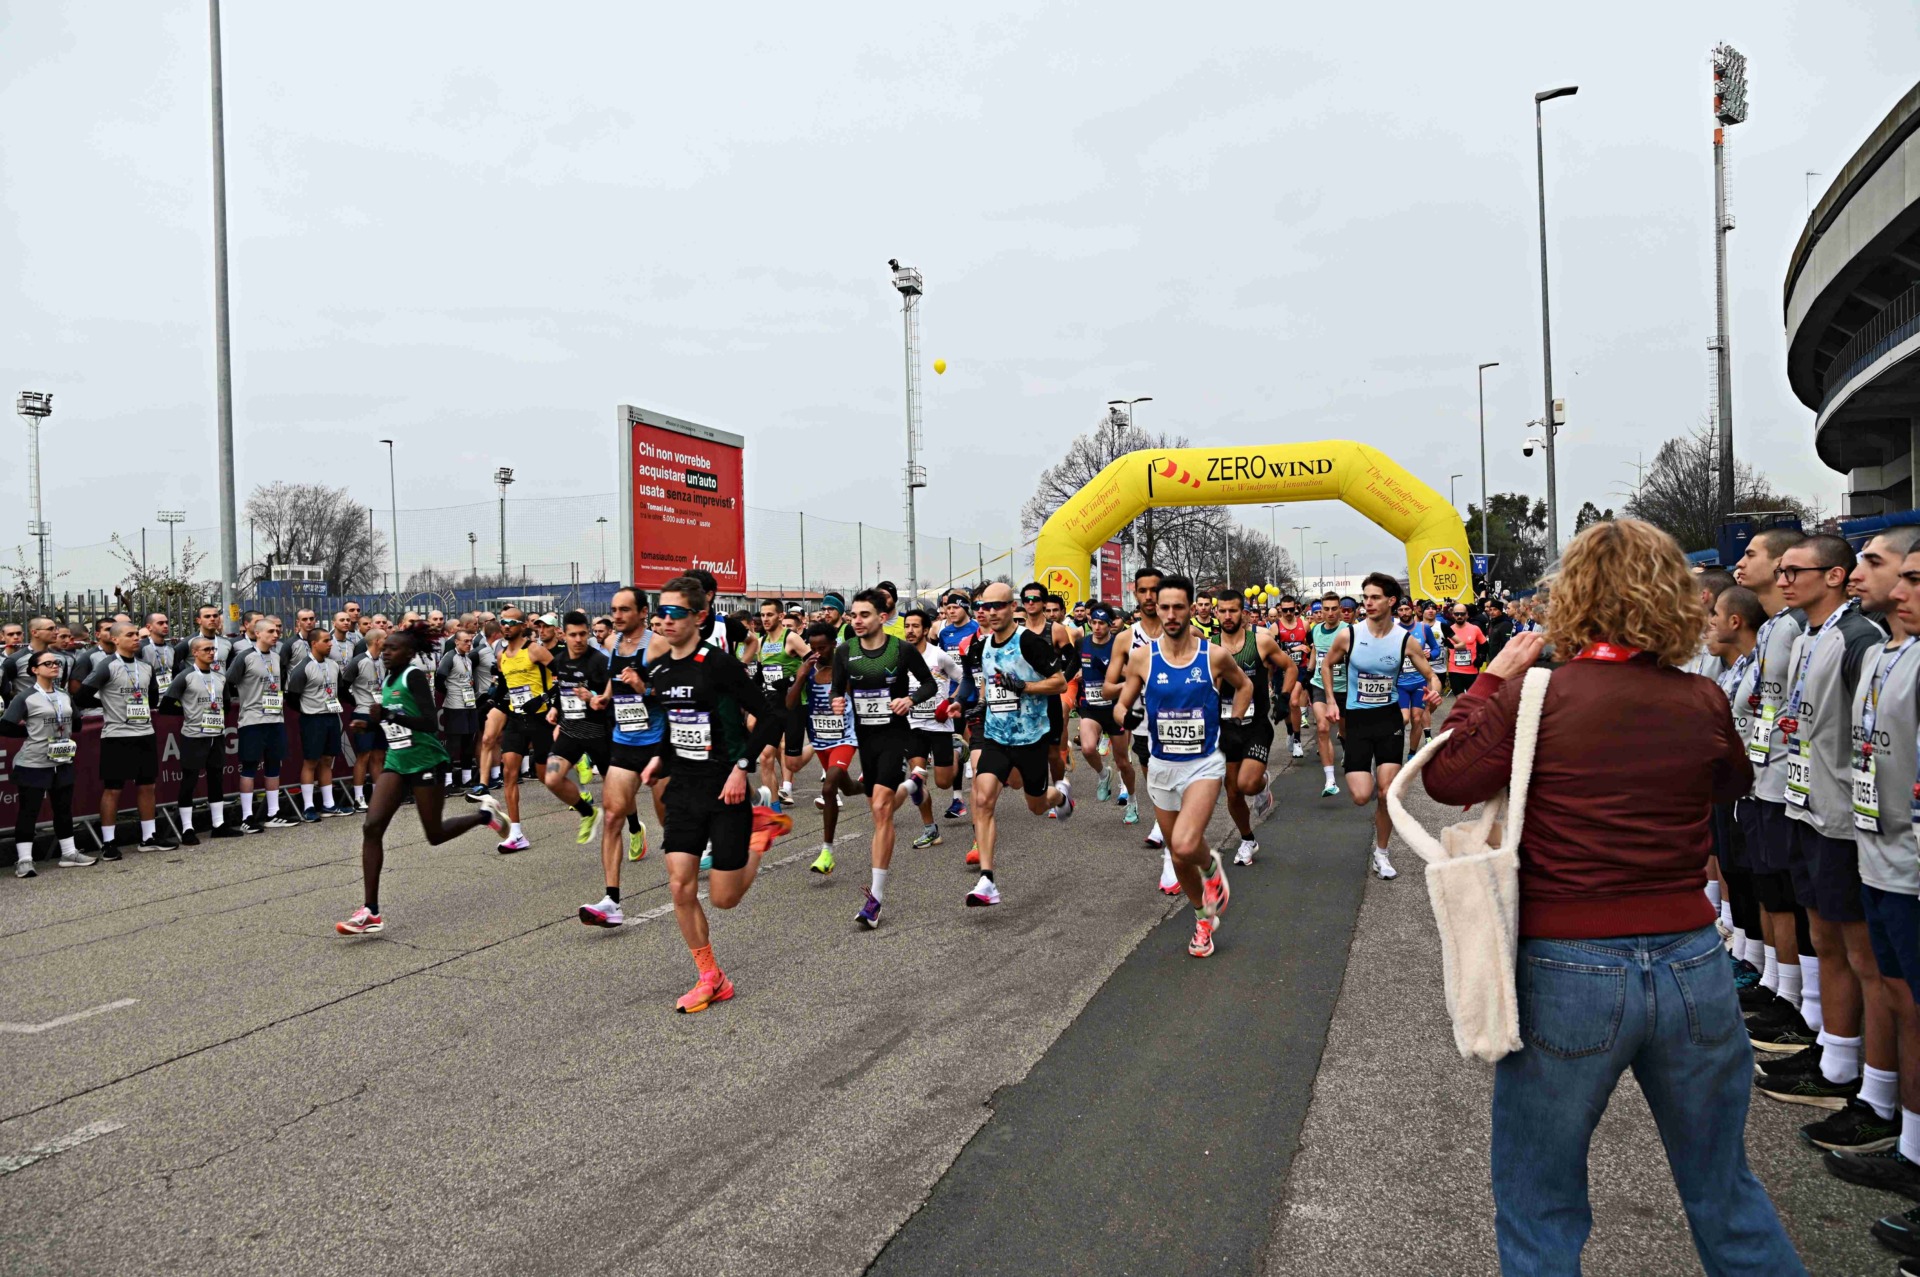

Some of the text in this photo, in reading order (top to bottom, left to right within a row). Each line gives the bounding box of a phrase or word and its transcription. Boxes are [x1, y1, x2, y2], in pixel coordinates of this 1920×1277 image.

[639, 442, 711, 469] Chi non vorrebbe
[639, 464, 717, 488] acquistare un'auto
[1221, 479, 1323, 492] The Windproof Innovation
[1366, 465, 1432, 514] The Windproof
[640, 485, 735, 509] usata senza imprevisti?
[1366, 481, 1410, 517] Innovation
[647, 503, 664, 512] Tomasi
[663, 505, 675, 514] Auto
[1063, 480, 1120, 531] The Windproof
[1081, 498, 1121, 533] Innovation
[641, 551, 688, 562] tomasiauto.com
[1433, 573, 1457, 585] ZERO
[1435, 584, 1458, 592] WIND
[671, 686, 694, 698] MET
[996, 688, 1006, 699] 30
[1365, 683, 1385, 693] 1276
[867, 703, 879, 713] 22
[814, 718, 843, 729] TEFERA
[1167, 725, 1196, 738] 4375
[171, 771, 184, 781] tu
